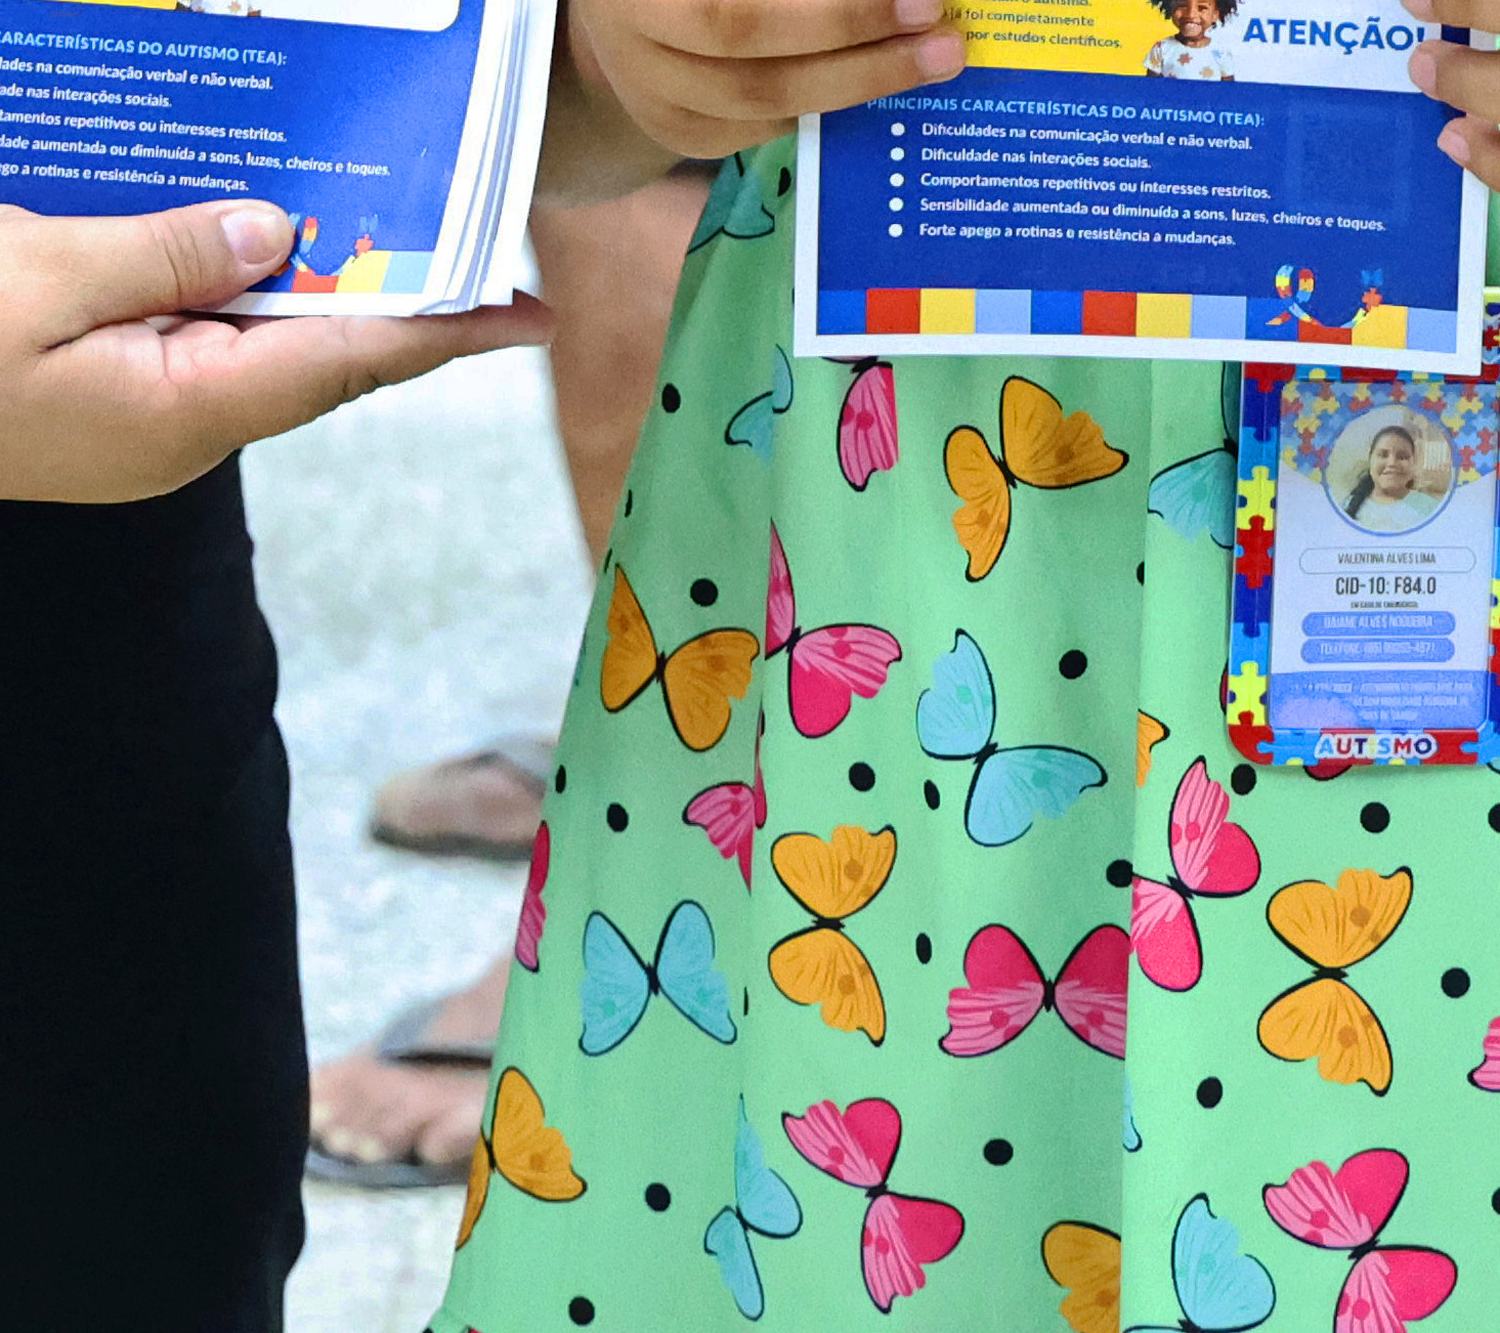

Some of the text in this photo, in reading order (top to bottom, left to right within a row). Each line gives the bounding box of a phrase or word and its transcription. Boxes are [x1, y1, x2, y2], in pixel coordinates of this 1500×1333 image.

[1243, 16, 1424, 55] ATENÇÃO!
[138, 41, 162, 55] DO
[165, 43, 239, 61] AUTISMO
[242, 49, 287, 66] (TEA):
[35, 62, 53, 73] na
[55, 63, 143, 81] comunicação
[145, 68, 187, 82] verbal
[189, 74, 198, 84] e
[200, 72, 226, 86] não
[229, 75, 273, 89] verbal.
[26, 87, 50, 98] nas
[52, 86, 122, 105] interações
[124, 93, 172, 107] sociais.
[867, 97, 1264, 127] PRINCIPAIS CARACTERÍSTICAS DO AUTISMO (TEA):
[920, 172, 1271, 199] Comportamentos repetitivos ou interesses restritos.
[920, 198, 1385, 231] Sensibilidade aumentada ou diminuída a sons, luzes, cheiros e toques.
[919, 223, 956, 236] Forte
[959, 226, 1001, 239] apego
[1004, 227, 1012, 237] a
[1015, 225, 1063, 238] rotinas
[1078, 228, 1150, 242] resistência
[1153, 232, 1161, 242] a
[1164, 230, 1235, 246] mudanças.
[1338, 553, 1384, 564] VALENTINA
[1336, 577, 1436, 595] CID-10: F84.0
[1320, 738, 1432, 755] AUTISMO
